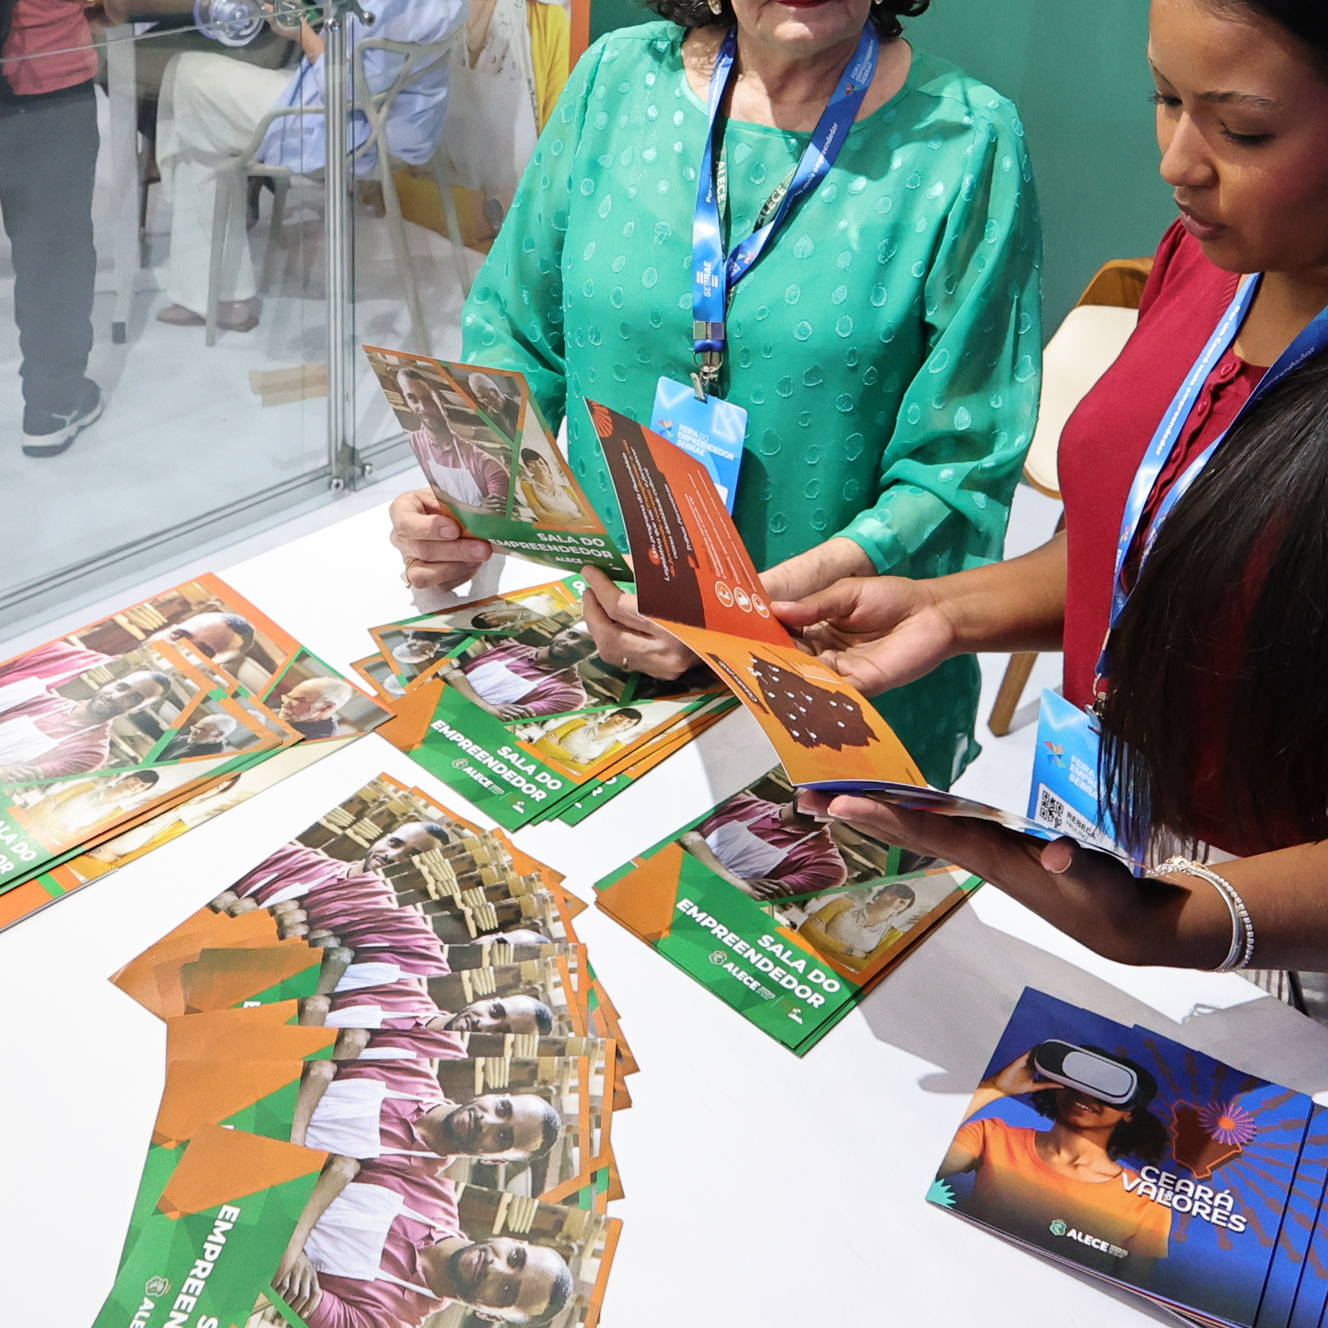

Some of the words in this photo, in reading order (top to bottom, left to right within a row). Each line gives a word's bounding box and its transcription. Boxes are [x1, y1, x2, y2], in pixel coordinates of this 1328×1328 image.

[813, 122, 839, 174] empreendedor
[703, 260, 712, 298] SEBRAE
[1190, 364, 1204, 386] mais
[678, 424, 698, 438] FEIRA
[698, 432, 710, 441] DO
[1156, 387, 1192, 456] empreendedor
[676, 439, 707, 457] SEBRAE
[677, 432, 736, 461] EMPREENDEDOR
[488, 538, 614, 559] EMPREENDEDOR
[536, 533, 579, 545] SALA
[580, 537, 605, 547] DO
[555, 556, 583, 564] ALECE
[430, 719, 547, 802] EMPREENDEDOR
[496, 746, 537, 776] SALA
[534, 773, 563, 791] DO
[463, 766, 494, 789] ALECE
[1066, 811, 1096, 840] REBECA
[11, 841, 38, 862] DO
[675, 898, 826, 1009] EMPREENDEDOR
[757, 934, 808, 973] SALA
[806, 968, 841, 993] DO
[723, 962, 760, 991] ALECE
[1122, 1171, 1248, 1233] VALORES
[1140, 1165, 1235, 1213] CEARÁ
[1067, 1228, 1110, 1252] ALECE
[162, 1204, 241, 1328] EMPREEN
